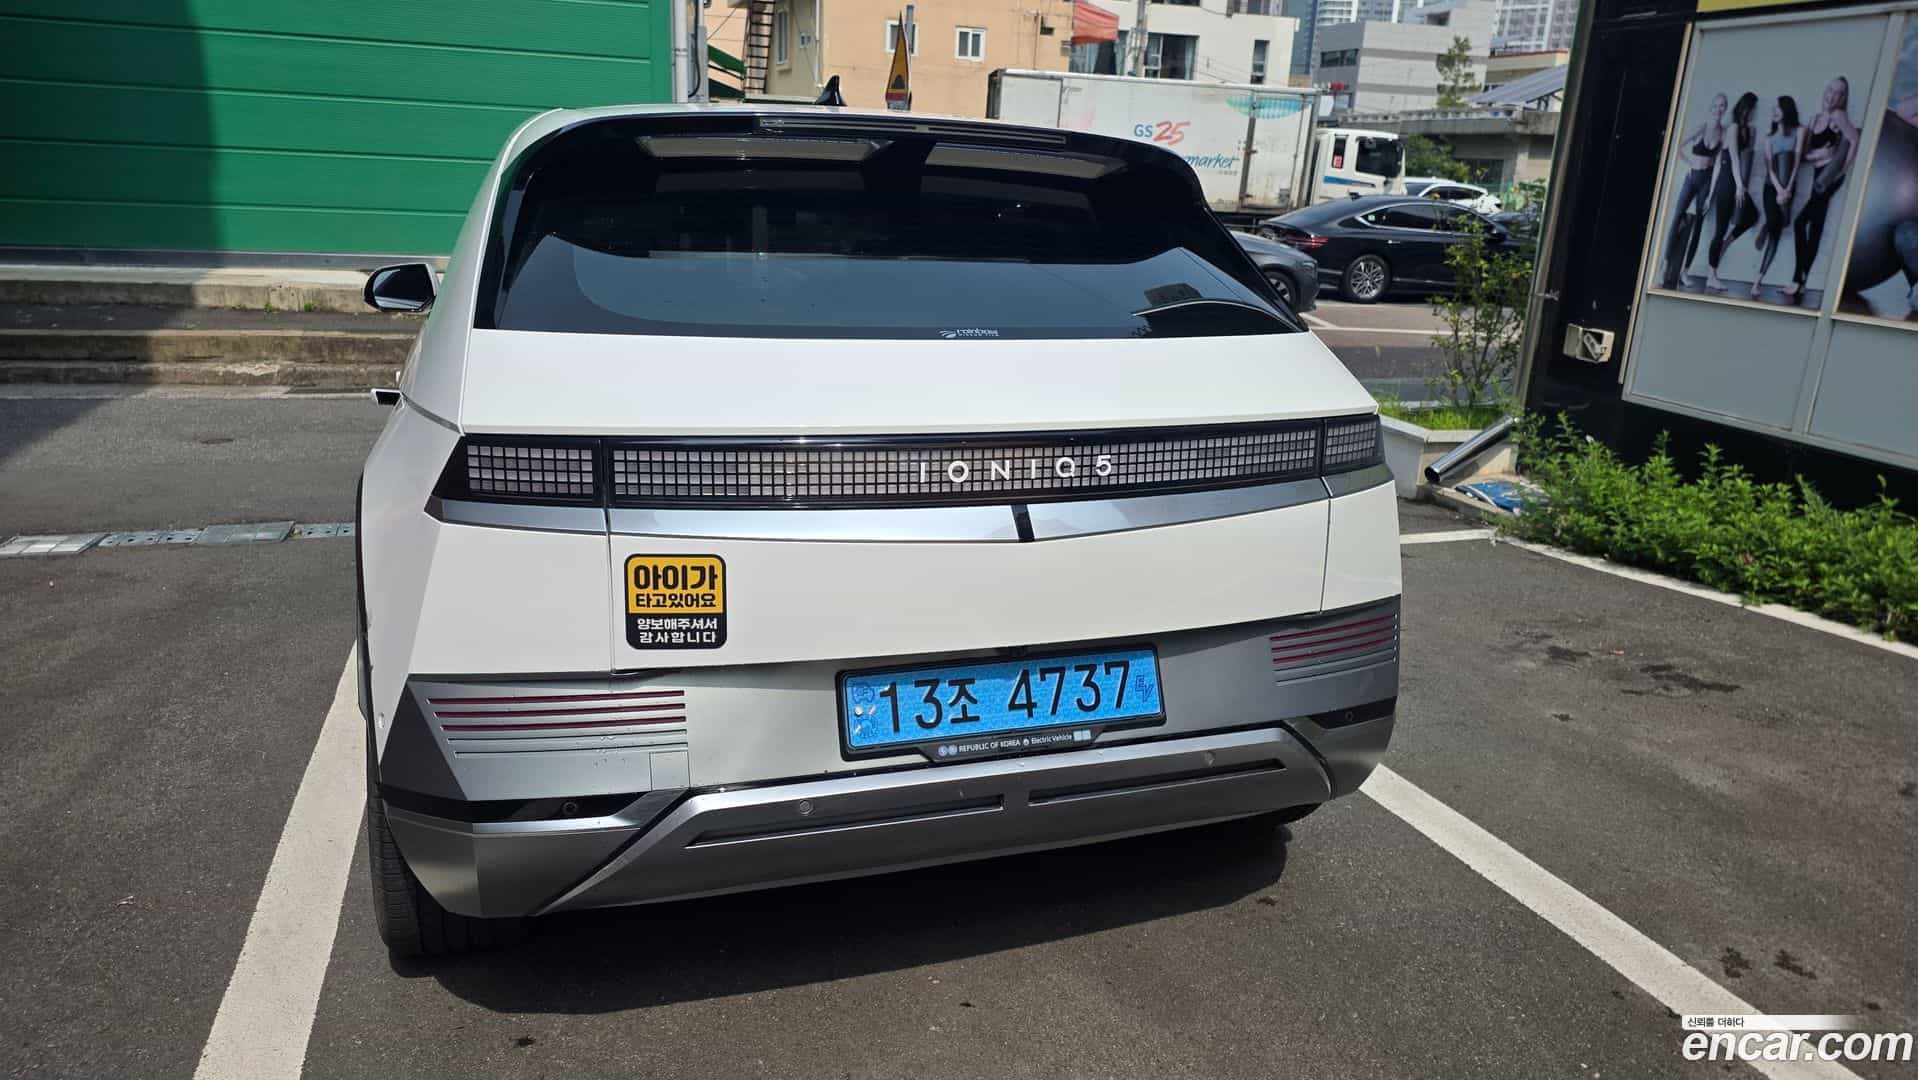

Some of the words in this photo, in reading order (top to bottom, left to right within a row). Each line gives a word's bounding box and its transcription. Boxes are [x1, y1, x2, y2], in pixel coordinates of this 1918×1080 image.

[920, 456, 1076, 484] IONIQ
[1095, 454, 1112, 477] 5
[634, 564, 718, 590] 아이가
[635, 593, 717, 608] 타고있어요
[637, 618, 718, 630] 양보해주셔서
[639, 631, 717, 644] 감사합니다
[879, 678, 980, 733] 13조
[1008, 660, 1130, 718] 4737
[1135, 675, 1154, 703] EV
[958, 742, 989, 753] REPUBLIC
[990, 740, 999, 749] OF
[1000, 738, 1021, 748] KOREA
[1031, 735, 1053, 745] Electric
[1052, 733, 1073, 742] Vehicle
